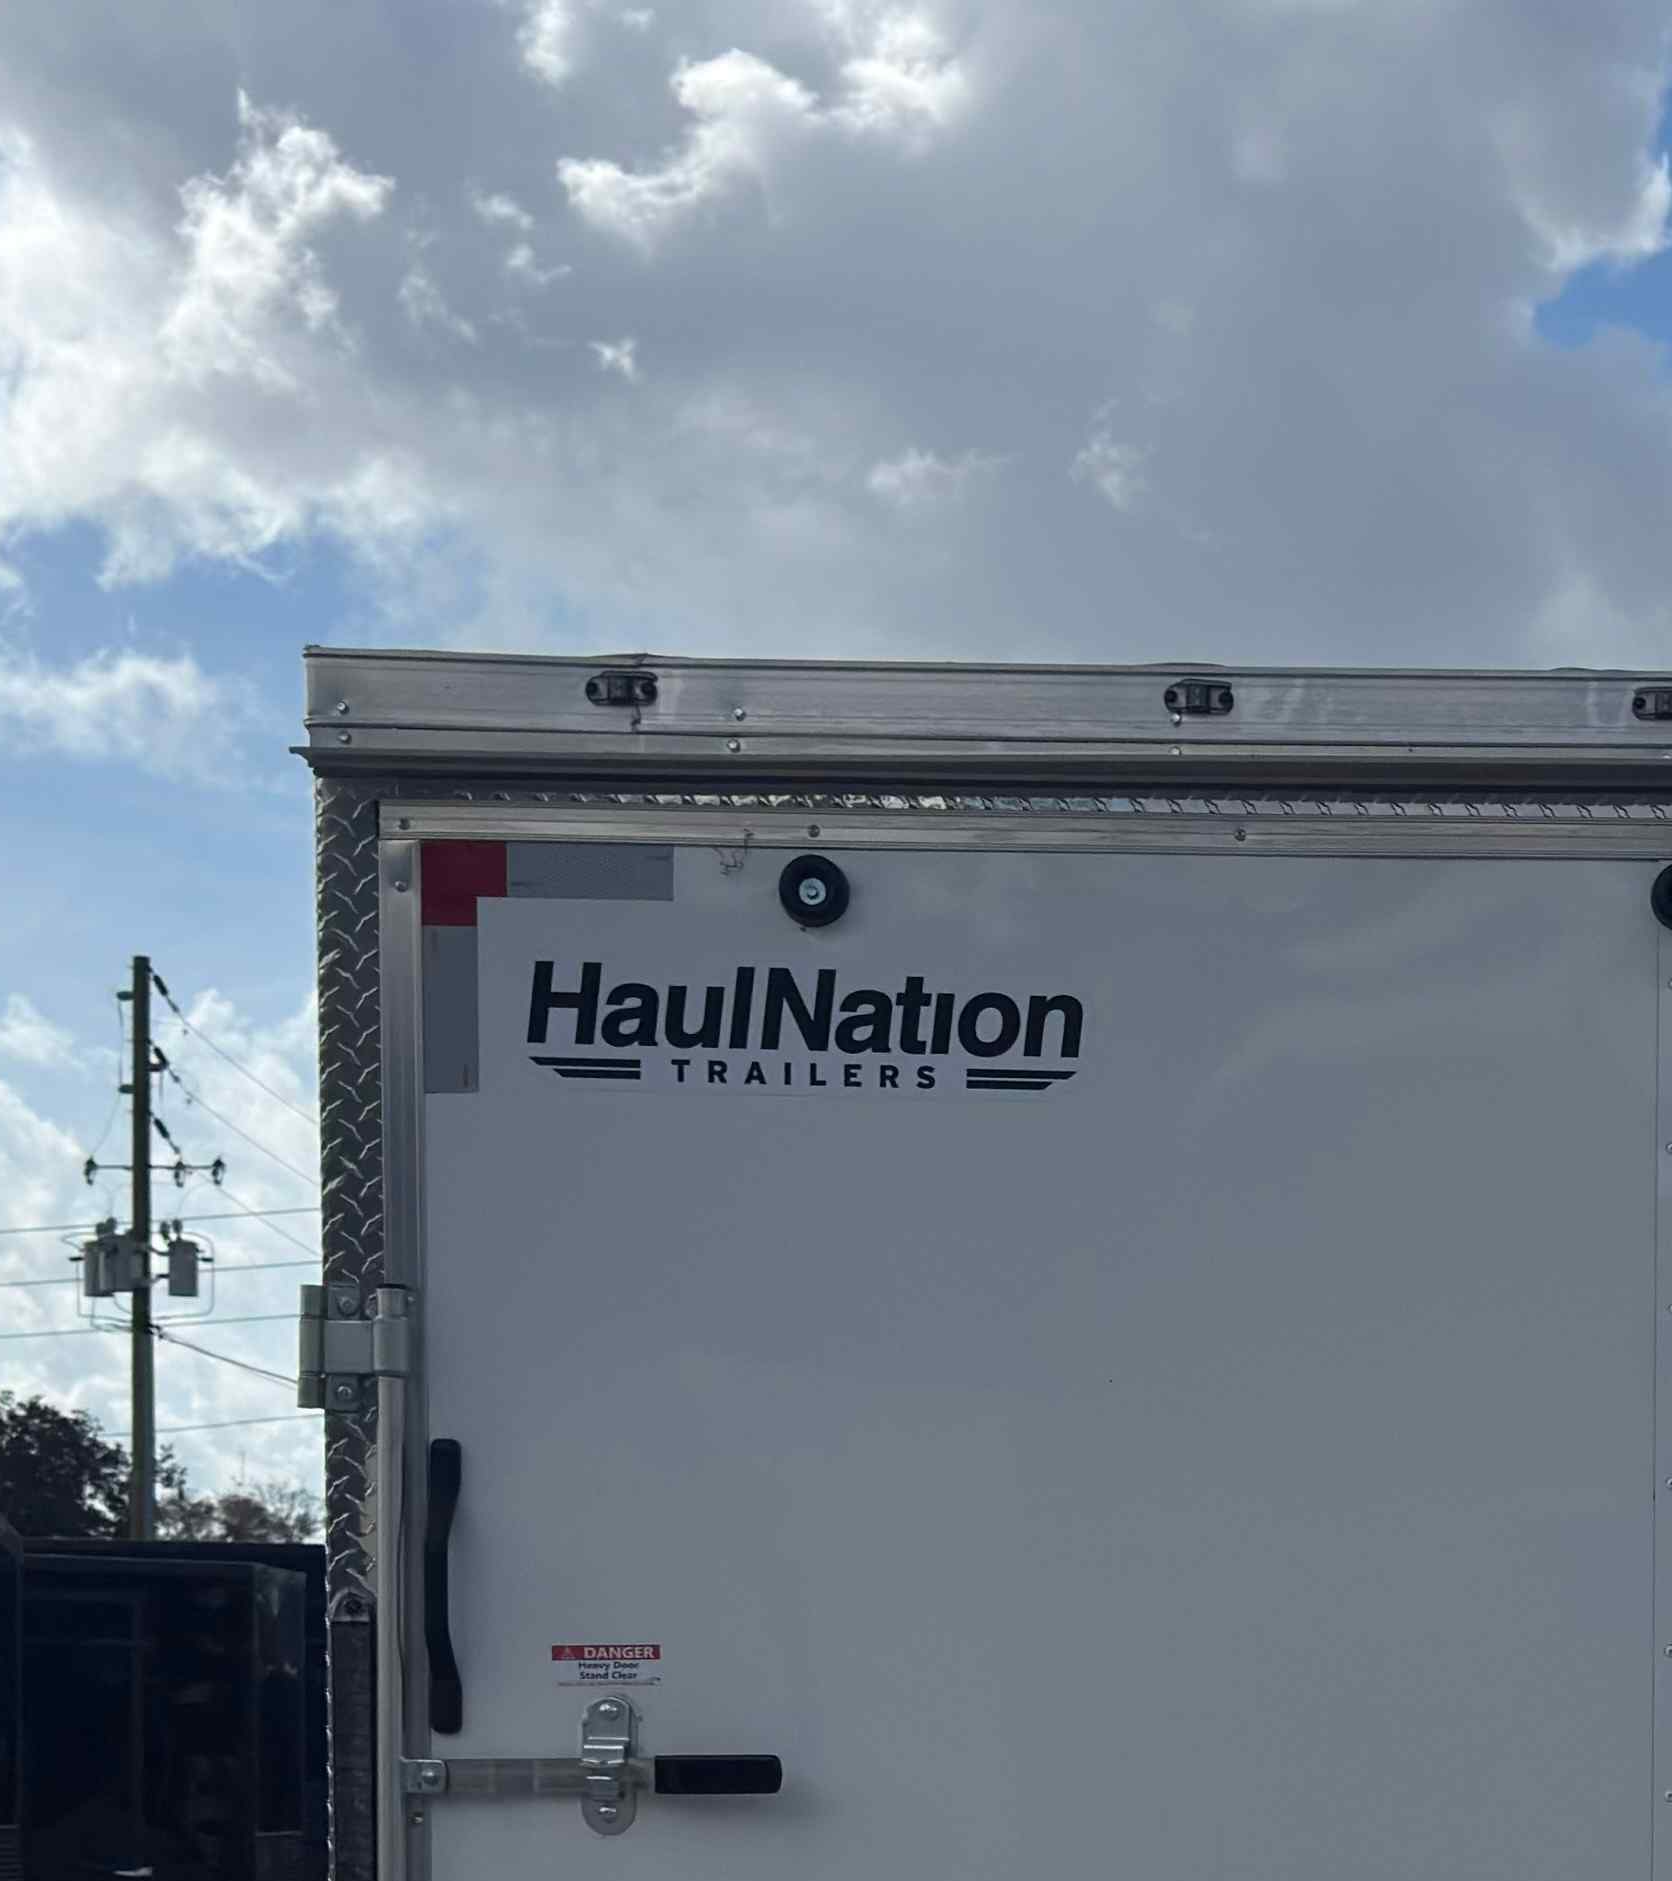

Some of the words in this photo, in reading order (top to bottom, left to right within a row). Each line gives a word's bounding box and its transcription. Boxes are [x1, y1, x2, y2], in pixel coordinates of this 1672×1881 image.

[527, 960, 1083, 1058] HaulNation
[671, 1058, 937, 1090] TRAILERS
[583, 1646, 655, 1659] DANGER
[613, 1661, 639, 1669] Door
[579, 1671, 608, 1680] Stand
[612, 1671, 637, 1680] Clear
